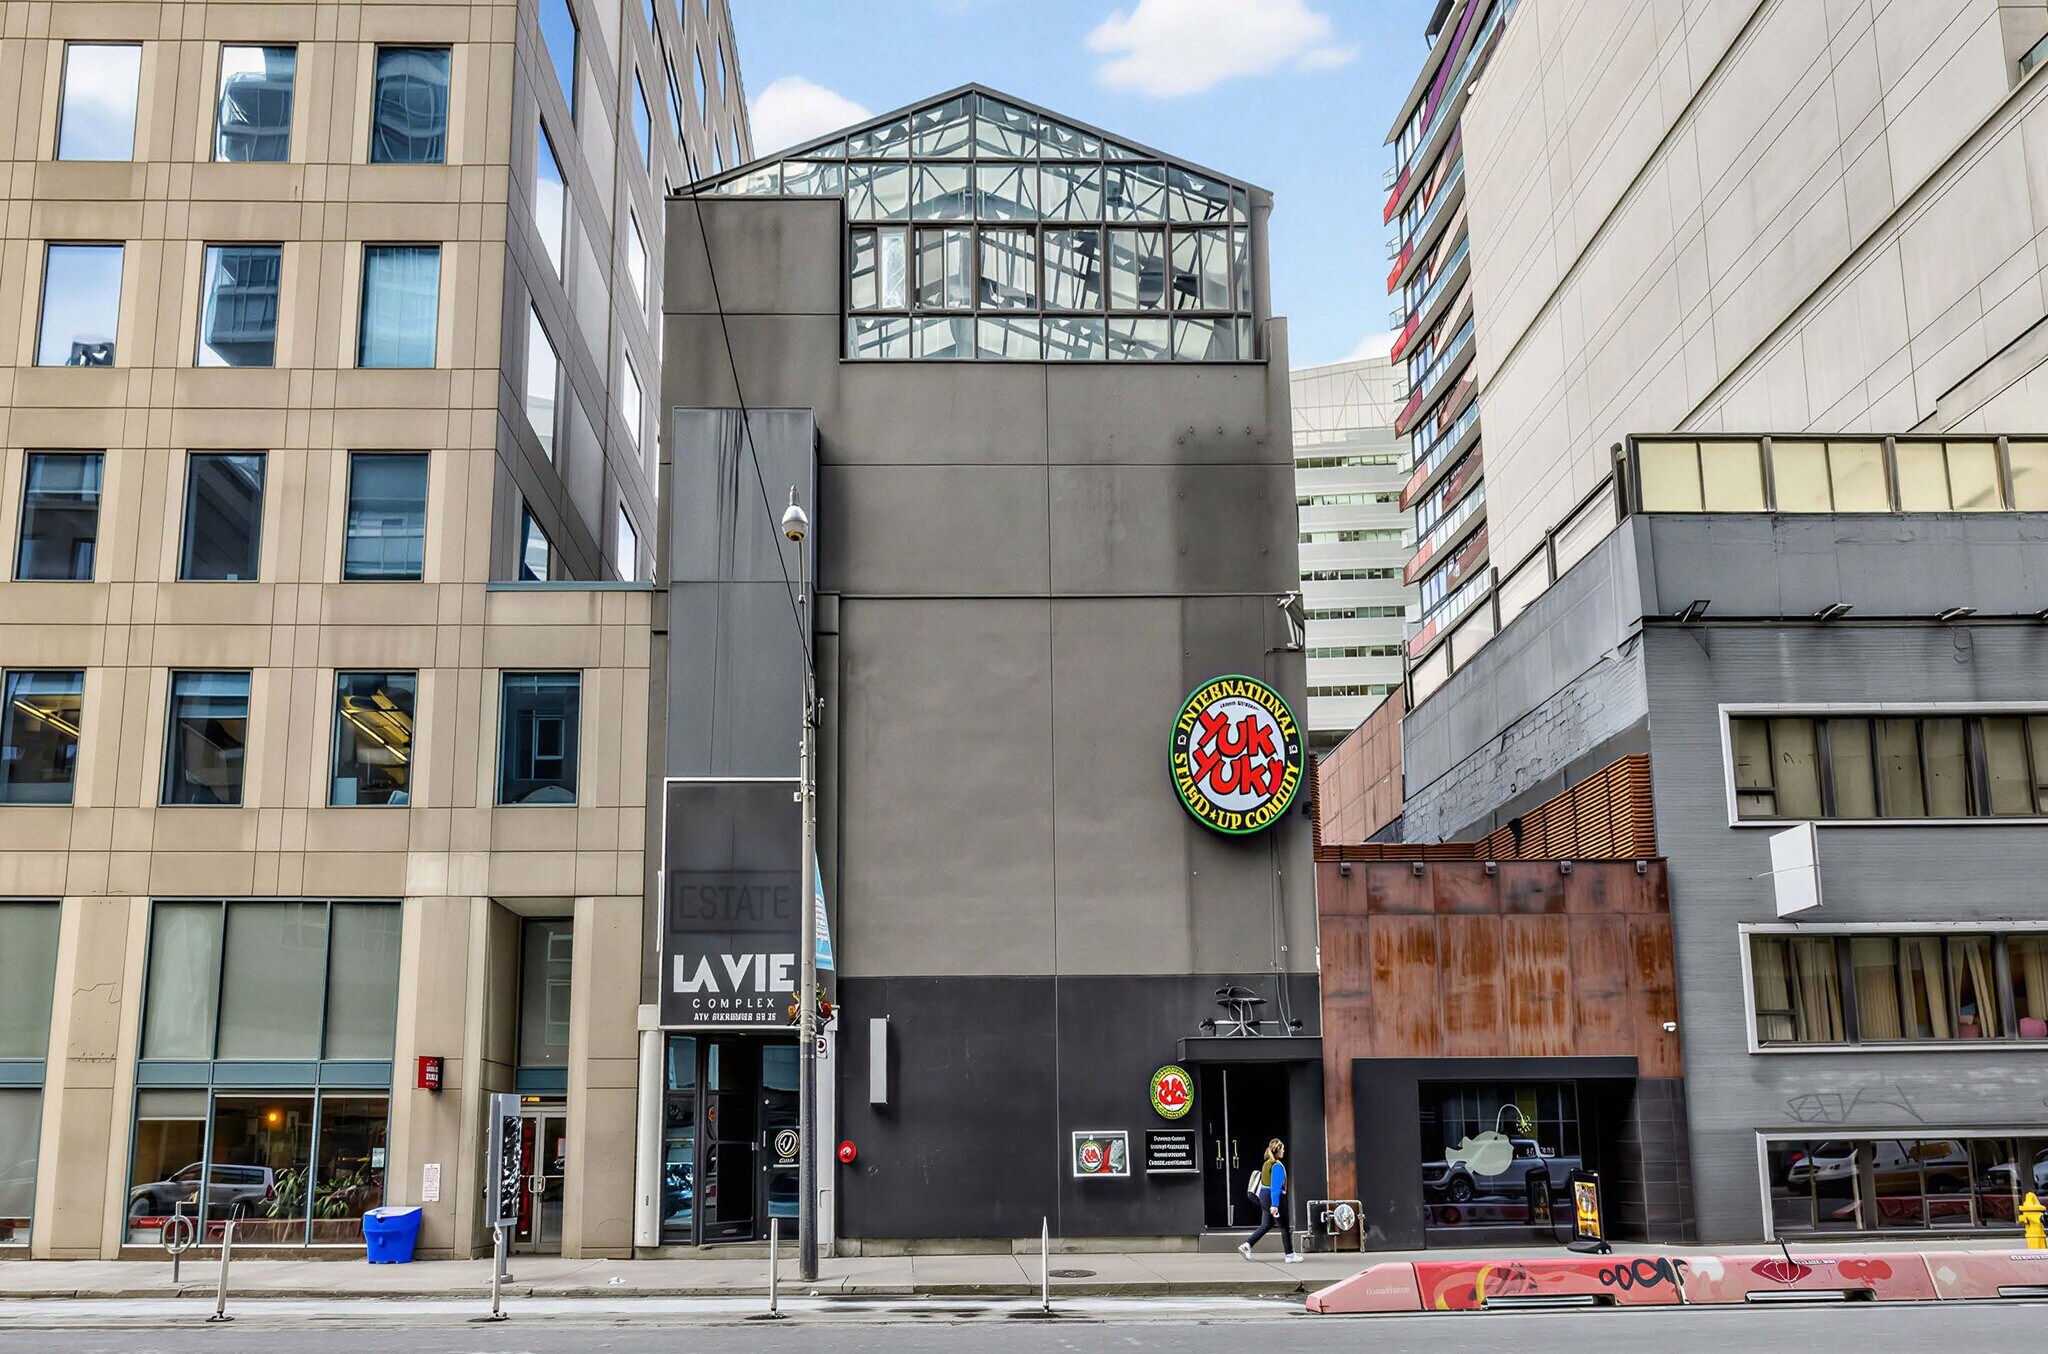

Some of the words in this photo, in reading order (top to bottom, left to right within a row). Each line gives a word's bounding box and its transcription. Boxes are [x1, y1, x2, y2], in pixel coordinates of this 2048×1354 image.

[1197, 710, 1276, 757] YUK
[1217, 810, 1242, 829] UP
[680, 884, 790, 921] ESTATE
[692, 998, 775, 1009] COMPLEX
